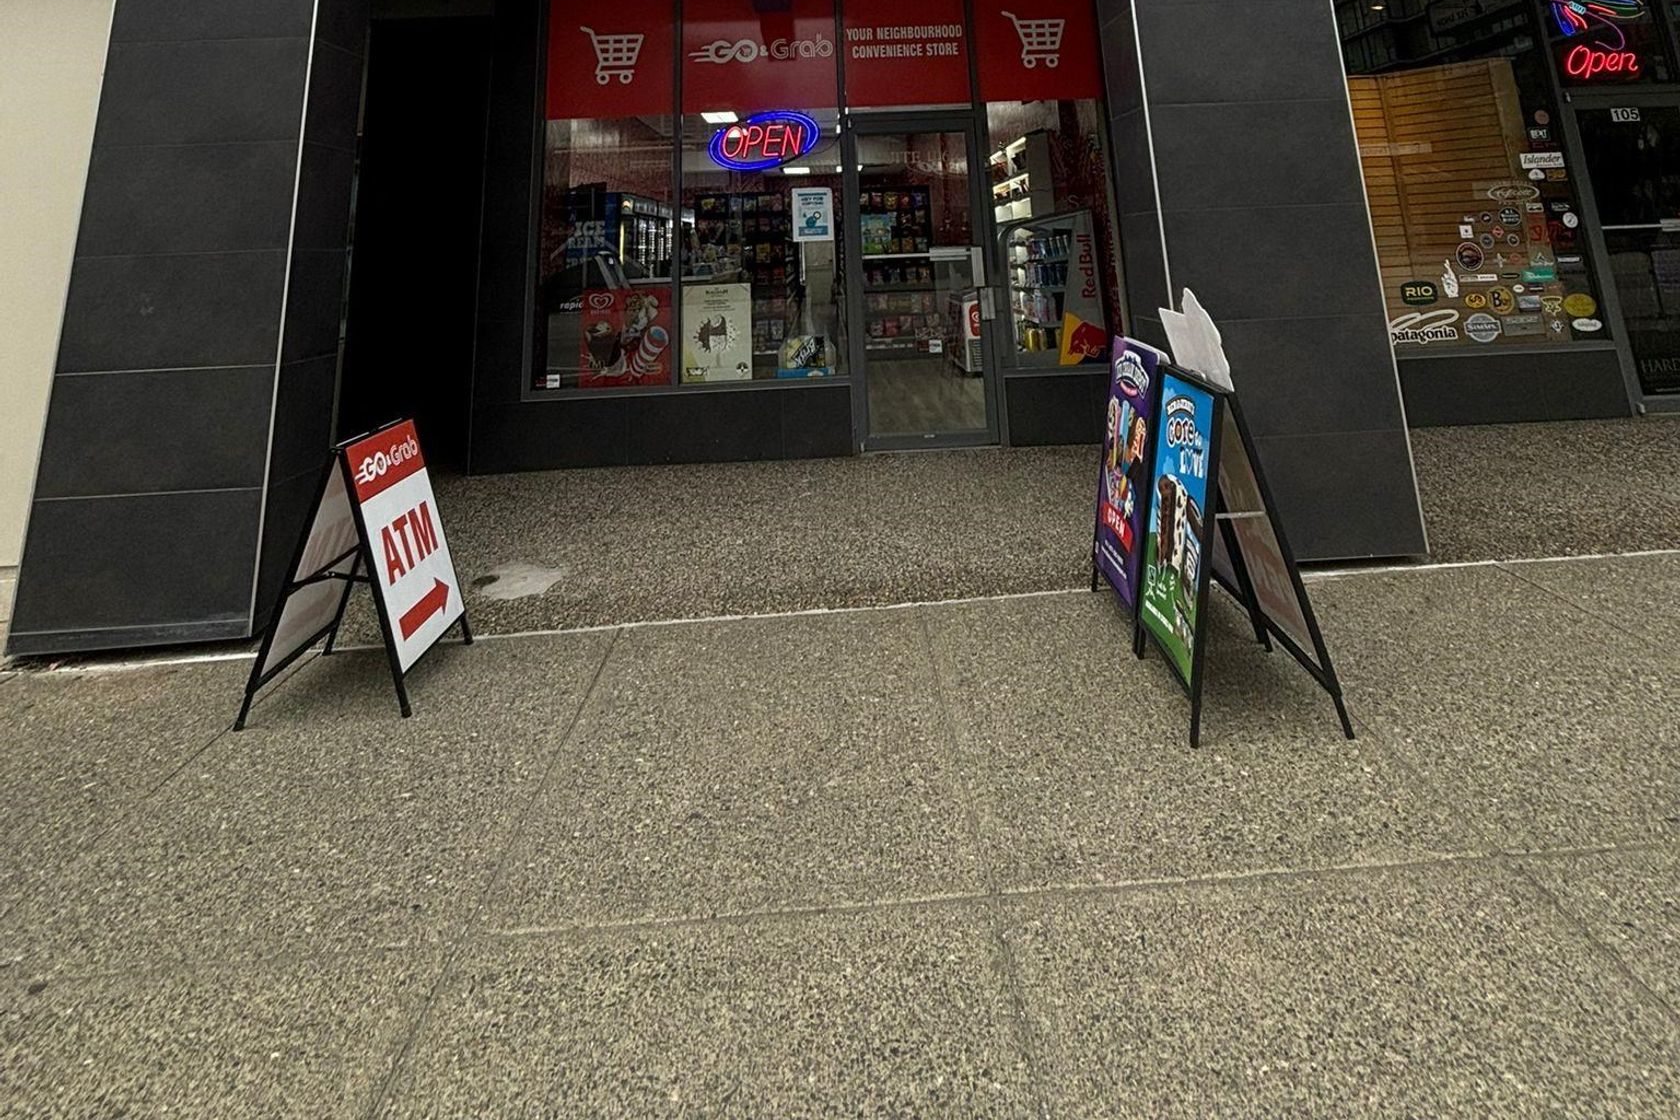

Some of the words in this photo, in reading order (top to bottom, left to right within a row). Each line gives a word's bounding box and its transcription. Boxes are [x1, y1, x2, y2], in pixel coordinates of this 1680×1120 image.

[770, 33, 834, 60] Grab
[846, 29, 874, 42] YOUR
[876, 25, 963, 40] NEIGHBOURHOOD
[852, 44, 924, 60] CONVENIENCE
[925, 43, 959, 57] STORE
[1567, 44, 1639, 79] Open
[1613, 108, 1639, 122] 105
[722, 124, 803, 160] OPEN
[1404, 285, 1433, 297] RIO
[391, 434, 419, 467] Grab
[1107, 507, 1126, 538] OPEN
[381, 500, 439, 586] ATM
